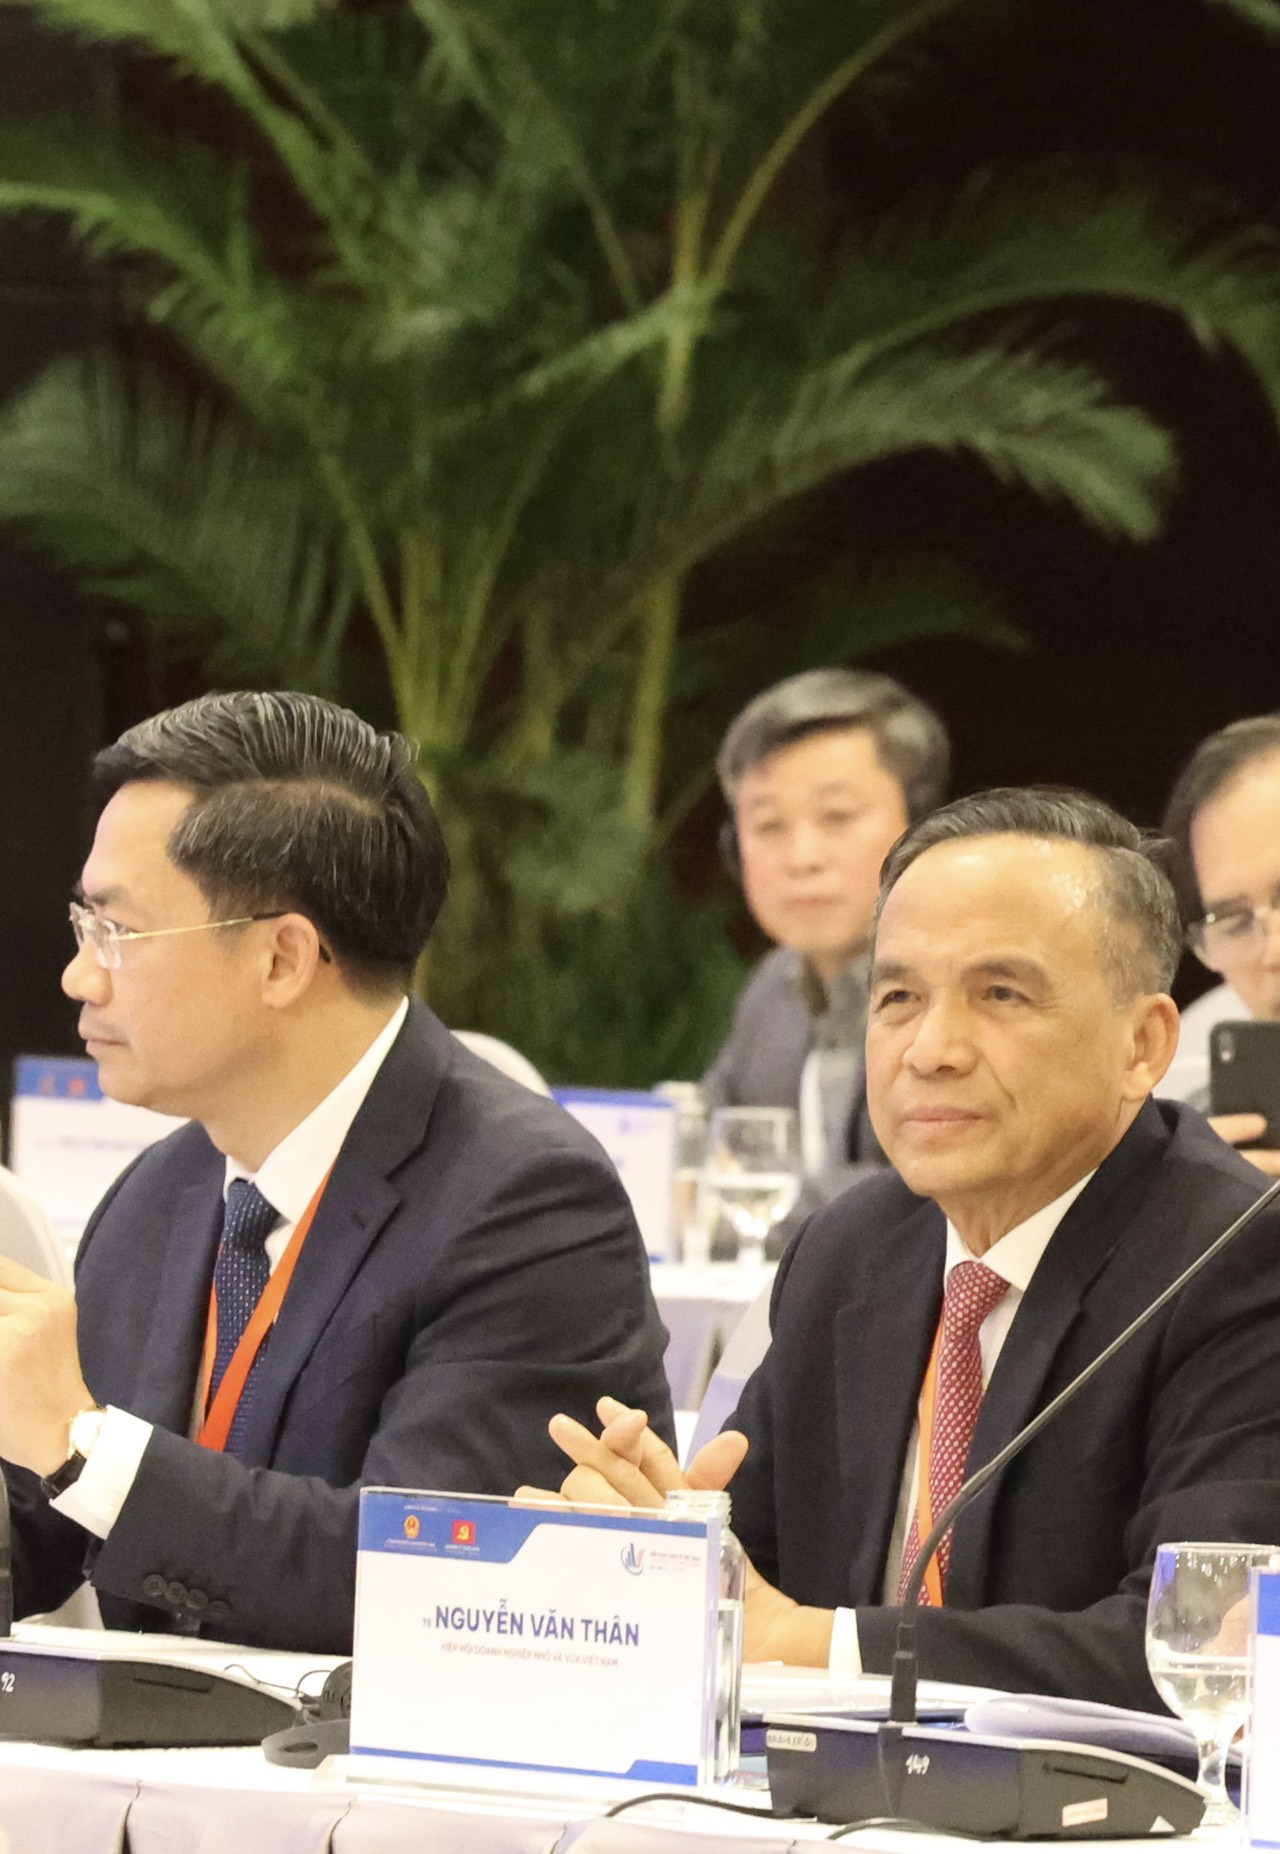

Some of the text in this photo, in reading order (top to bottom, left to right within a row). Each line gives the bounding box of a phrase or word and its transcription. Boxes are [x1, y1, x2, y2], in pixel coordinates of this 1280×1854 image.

[436, 1598, 524, 1635] NGUYỄN
[531, 1608, 575, 1640] VĂN
[581, 1614, 639, 1646] THÂN
[601, 1656, 618, 1667] NAM
[1, 1671, 15, 1692] 92
